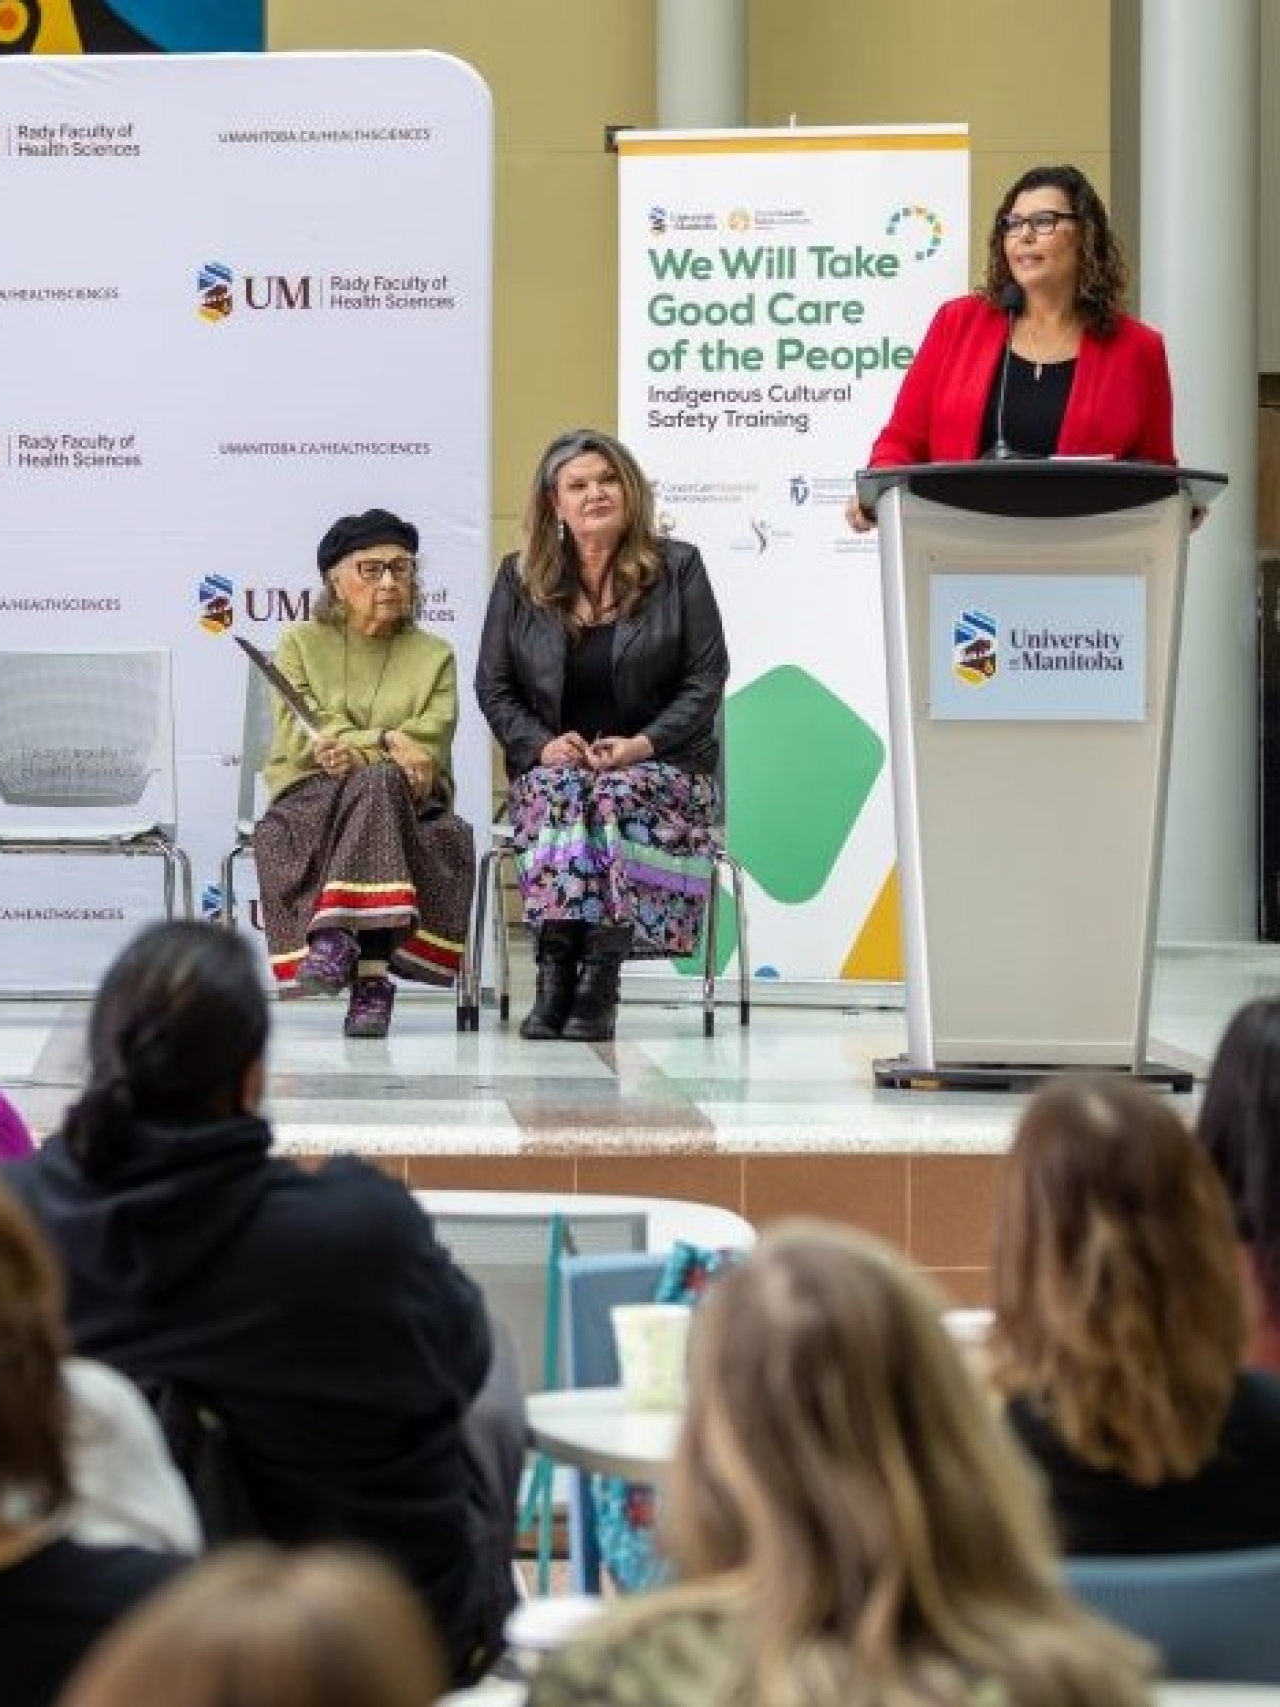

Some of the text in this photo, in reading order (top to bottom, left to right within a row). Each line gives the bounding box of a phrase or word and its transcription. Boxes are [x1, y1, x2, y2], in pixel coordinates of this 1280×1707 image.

[18, 123, 133, 139] Rady Faculty of
[219, 129, 430, 142] UMANITOBA.CA/HEALTHSCIENCES
[18, 143, 141, 156] Health Sciences
[648, 246, 900, 280] We Will Take
[244, 276, 312, 309] UM
[331, 276, 447, 292] Rady Faculty of
[331, 294, 455, 309] Health Sciences
[648, 293, 865, 326] Good Care
[647, 338, 914, 378] of the People
[648, 385, 852, 407] Indigenous Cultural
[648, 410, 810, 433] Safety Training
[19, 435, 135, 450] Rady Faculty of
[219, 442, 431, 455] UMANITOBA.CA/HEALTHSCIENCES
[19, 453, 142, 466] Health Sciences
[244, 588, 311, 622] UM
[1009, 629, 1124, 651] University
[1021, 651, 1125, 671] Manitoba
